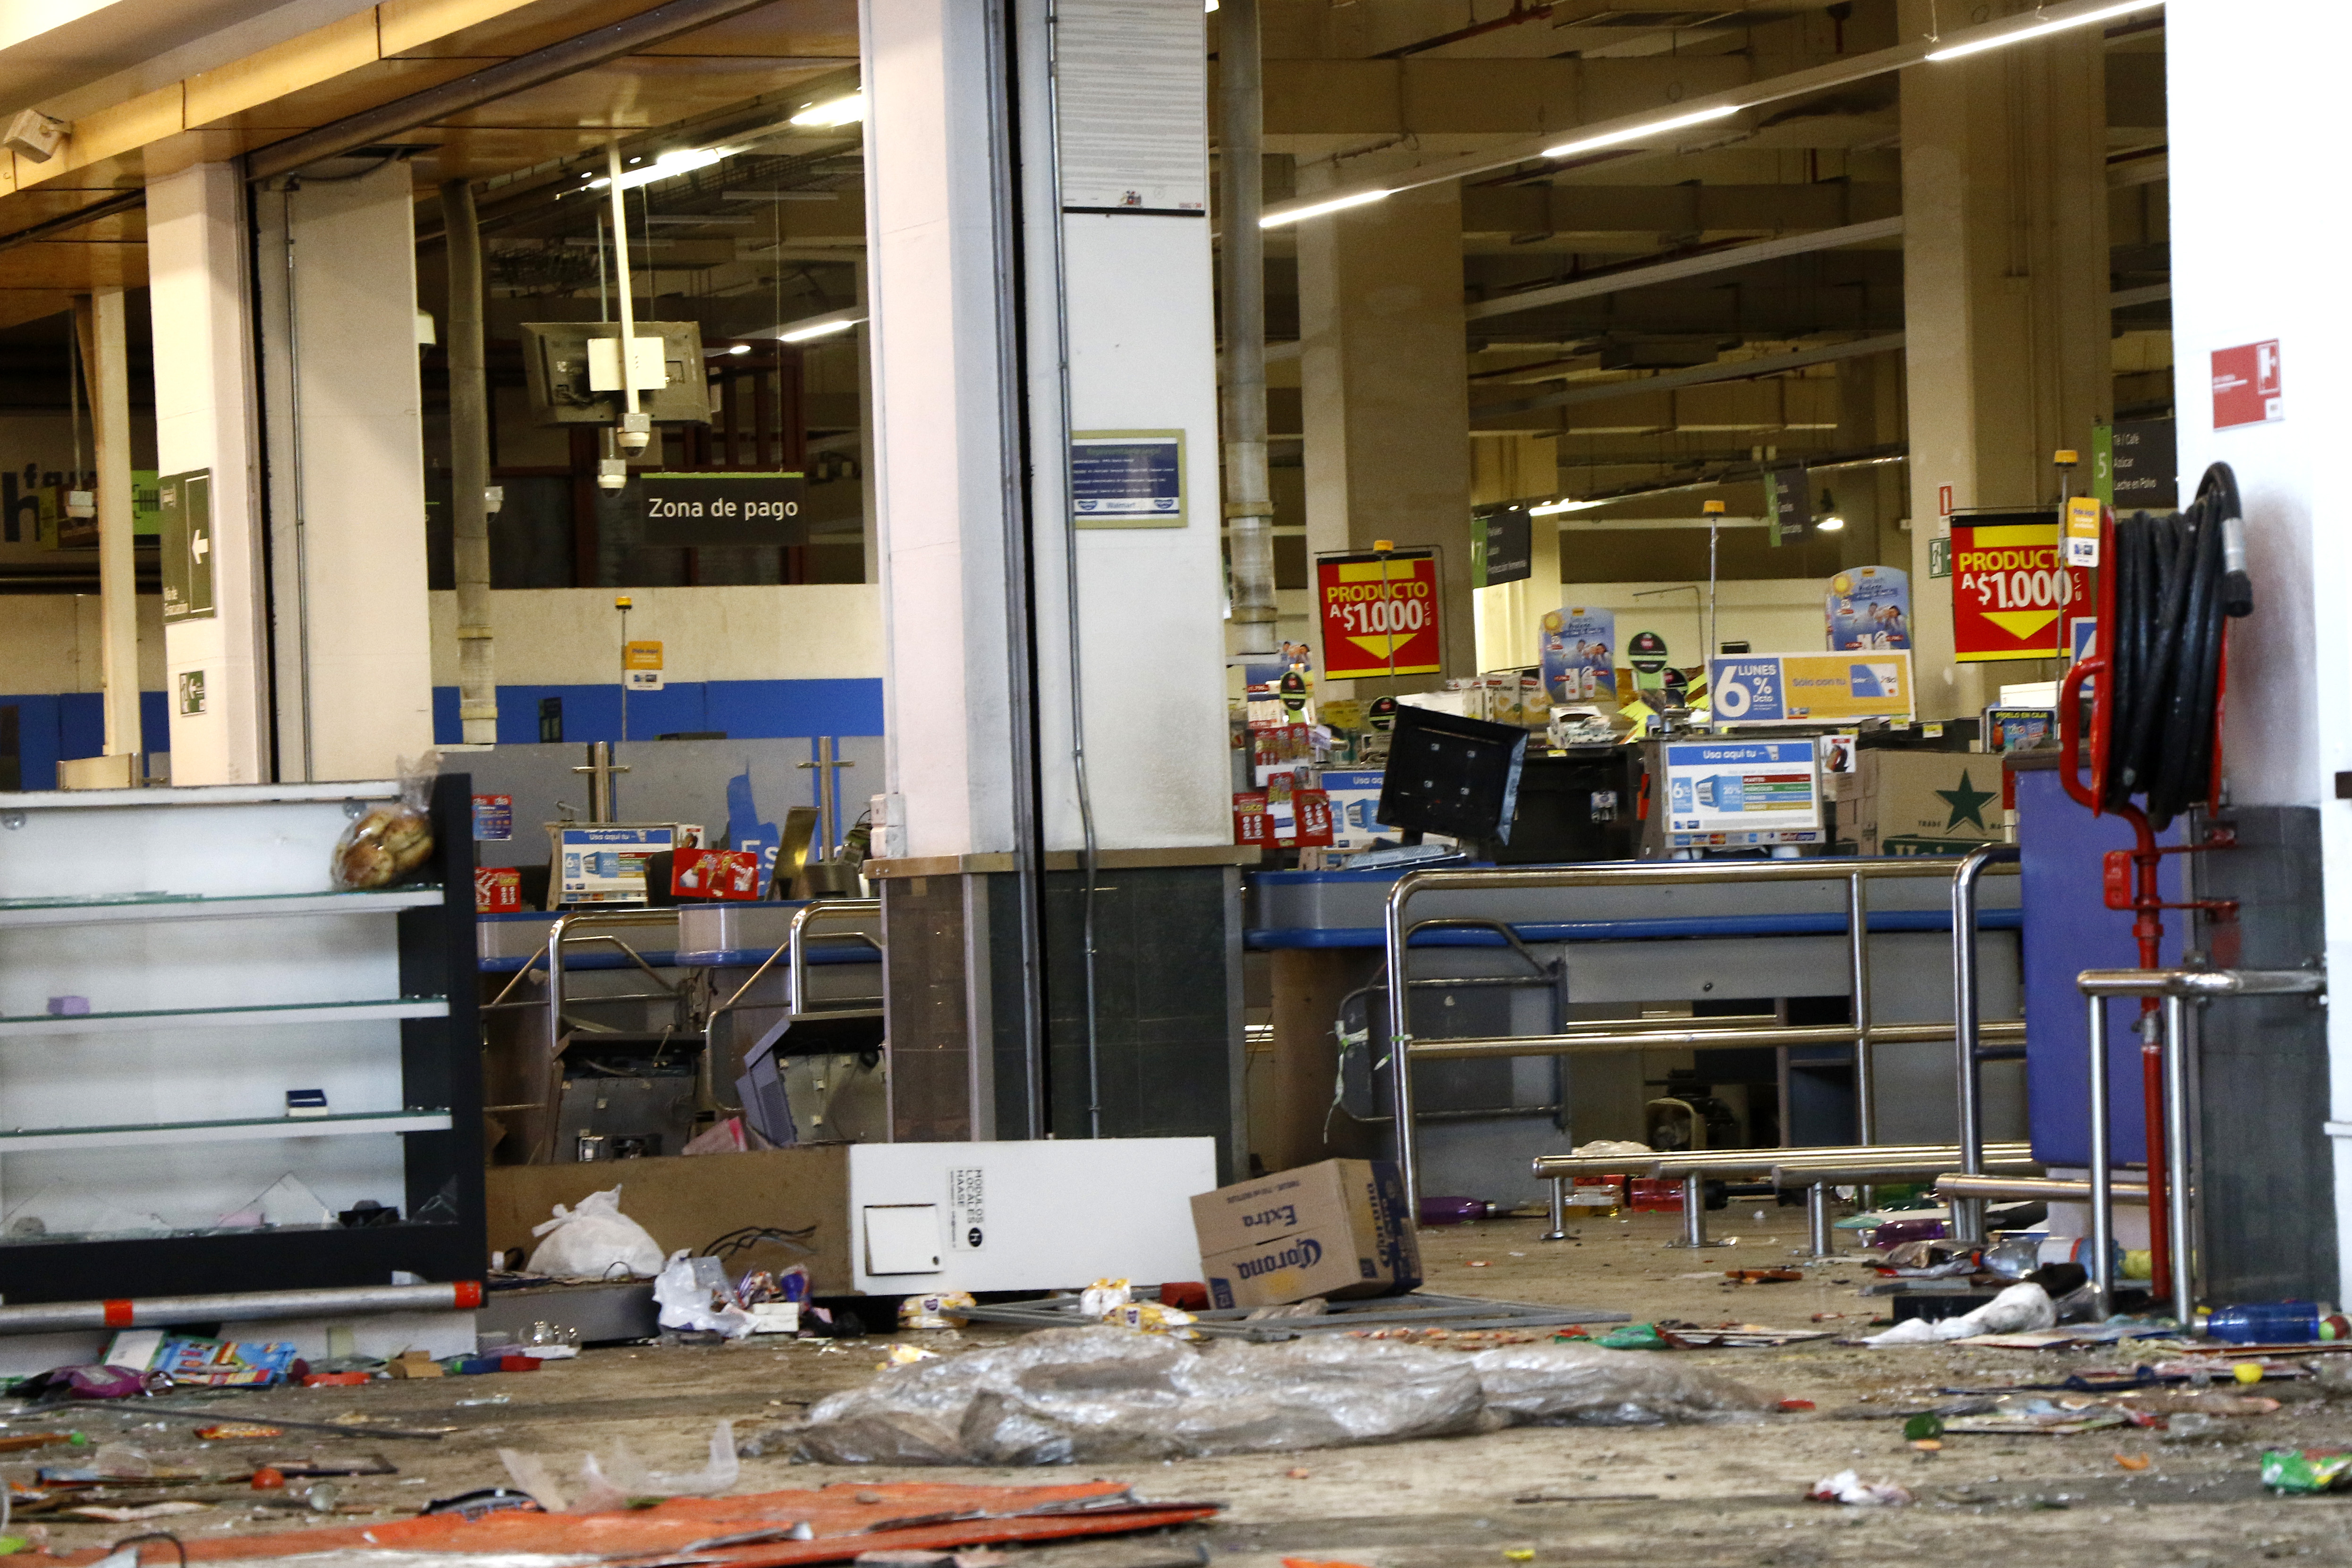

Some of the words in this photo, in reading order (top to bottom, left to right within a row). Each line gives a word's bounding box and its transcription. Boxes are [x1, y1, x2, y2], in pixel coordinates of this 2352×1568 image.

[2098, 452, 2107, 478] 5
[648, 498, 704, 517] Zona
[710, 497, 737, 517] de
[744, 501, 799, 521] pago
[1959, 549, 2074, 572] PRODUCT
[1327, 581, 1429, 603] PRODUCTO
[1961, 573, 1975, 590] A
[1977, 569, 2073, 609] $1.000
[1329, 604, 1342, 618] A
[1342, 599, 1424, 633] $1.000
[1714, 665, 1751, 718] 6
[1738, 664, 1777, 677] LUNES
[1753, 677, 1772, 695] %
[1753, 694, 1774, 703] Dcto
[1703, 750, 1722, 759] Usa
[1723, 749, 1745, 760] aquí
[1746, 749, 1757, 758] tu
[1353, 776, 1370, 784] Usa
[1371, 777, 1384, 785] aq
[967, 1170, 975, 1223] LOCALES
[1242, 1204, 1298, 1227] Extra
[1233, 1238, 1322, 1280] Corona
